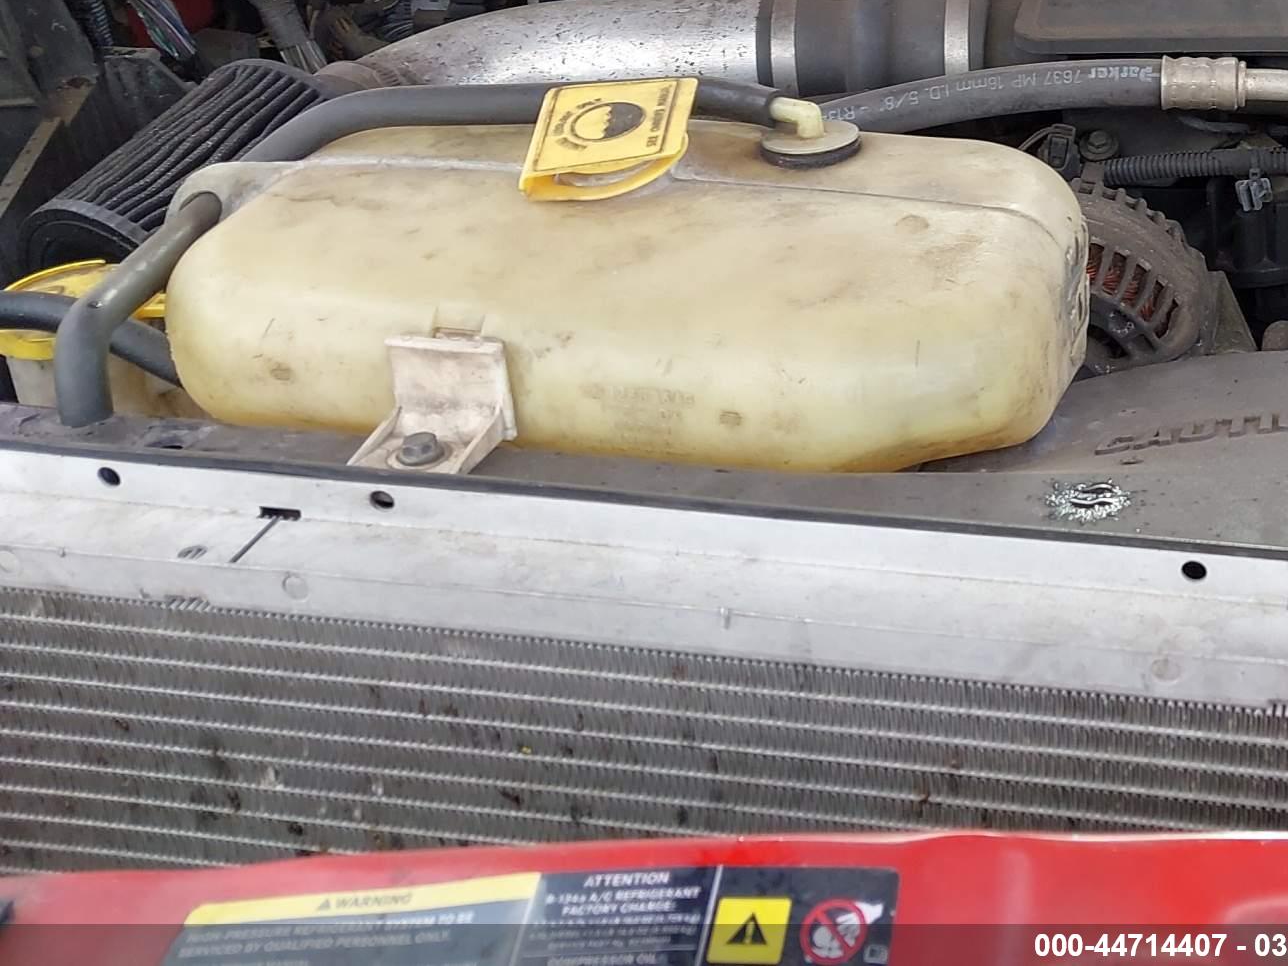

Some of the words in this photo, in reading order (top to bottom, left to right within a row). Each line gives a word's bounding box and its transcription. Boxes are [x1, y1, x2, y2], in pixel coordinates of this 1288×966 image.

[1013, 73, 1037, 88] MP
[1044, 70, 1083, 85] 7637
[1087, 66, 1155, 83] Parker
[955, 76, 1004, 93] 16mm
[584, 872, 671, 888] ATTENTION
[335, 893, 412, 909] WARNING
[590, 890, 613, 903] A/C
[615, 886, 702, 900] REFRIGERANT
[562, 903, 618, 916] FACTORY
